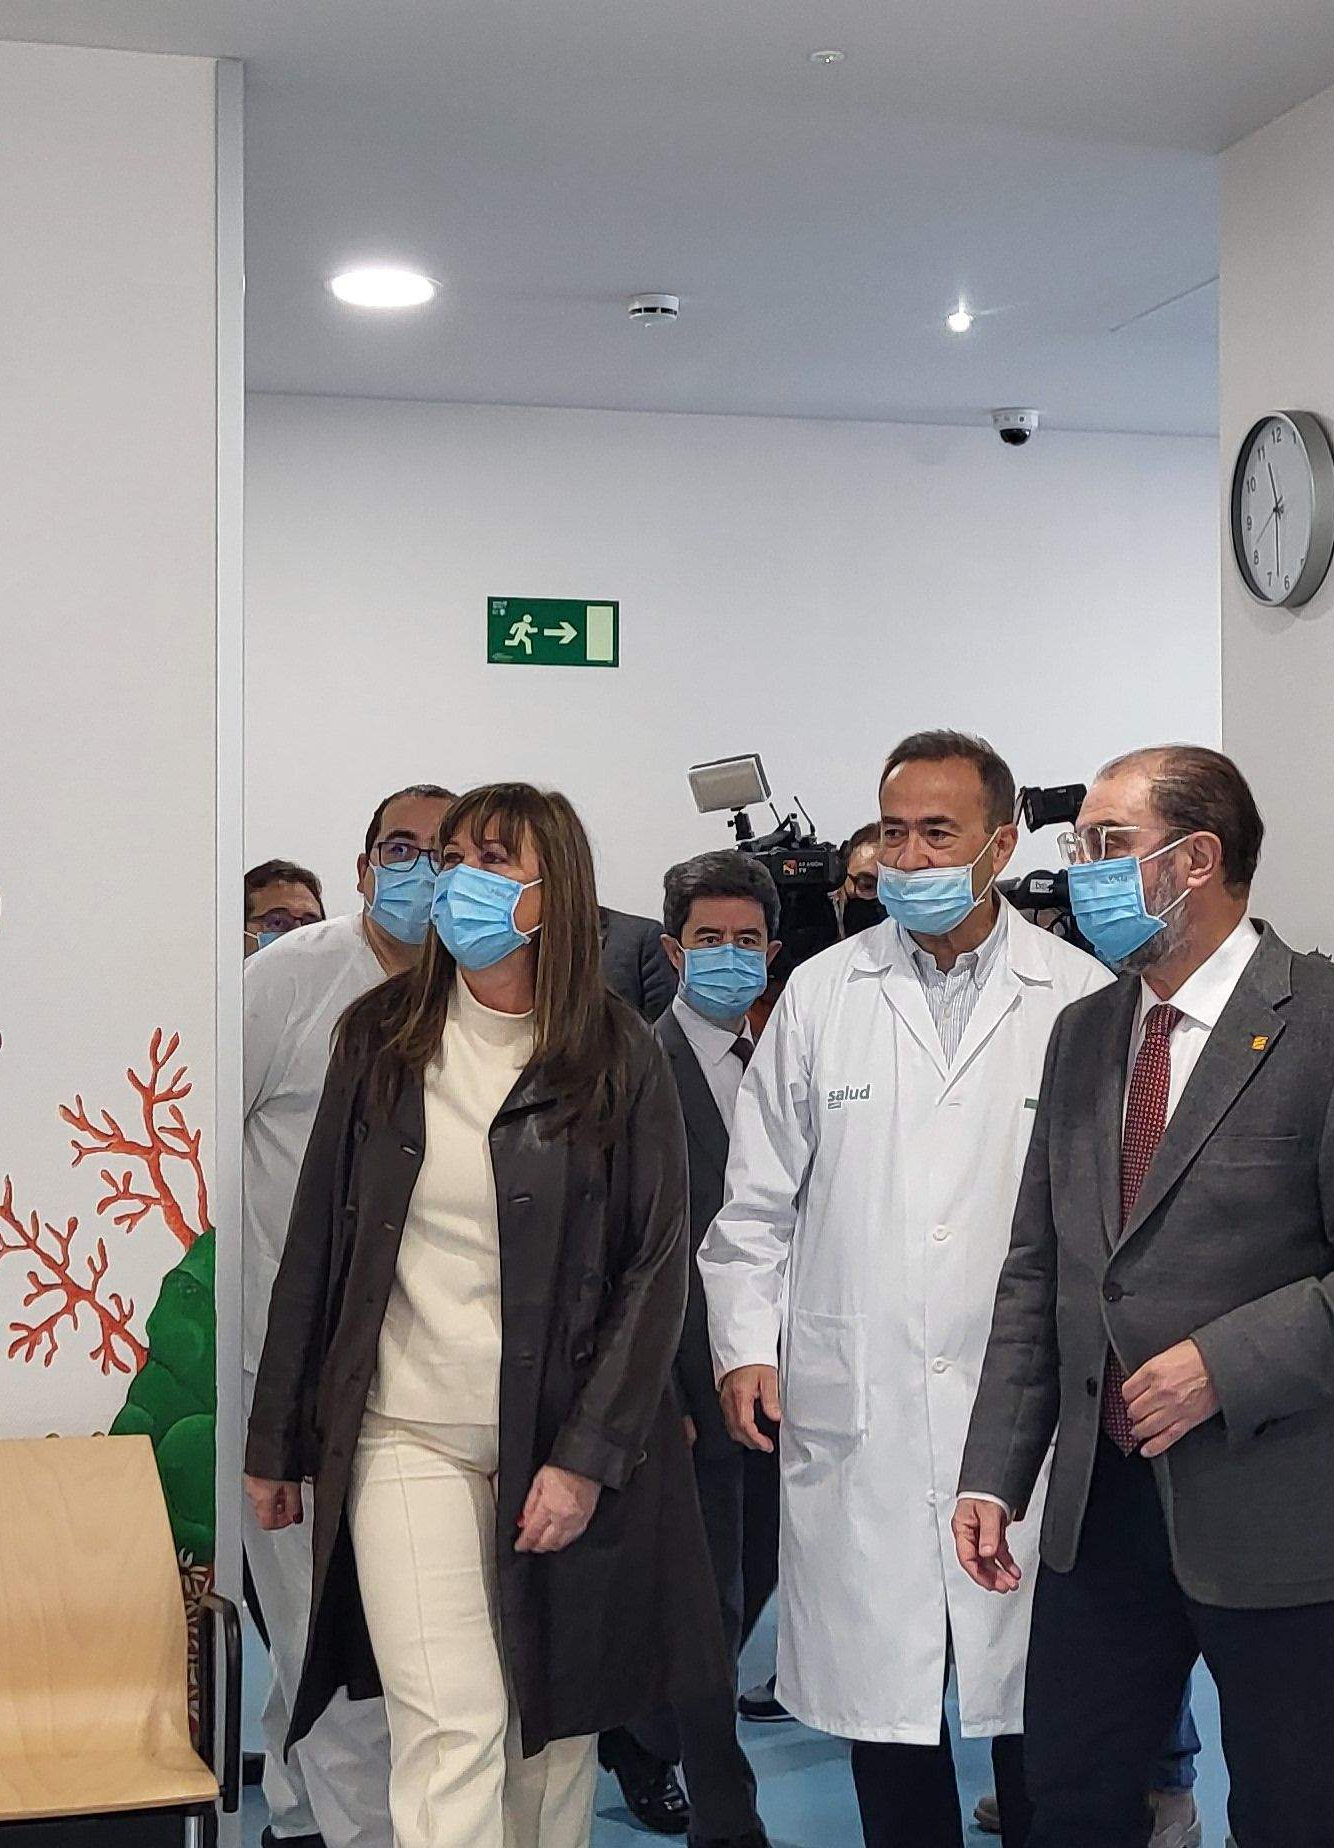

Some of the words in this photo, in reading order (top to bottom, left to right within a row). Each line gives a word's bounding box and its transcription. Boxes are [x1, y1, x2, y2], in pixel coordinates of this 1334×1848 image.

[1271, 426, 1282, 445] 12
[1257, 446, 1266, 462] 11
[1246, 475, 1257, 494] 10
[1246, 515, 1253, 532] 9
[1253, 549, 1260, 566] 8
[1266, 570, 1273, 587] 7
[1283, 574, 1291, 591] 6
[827, 1083, 871, 1102] salud
